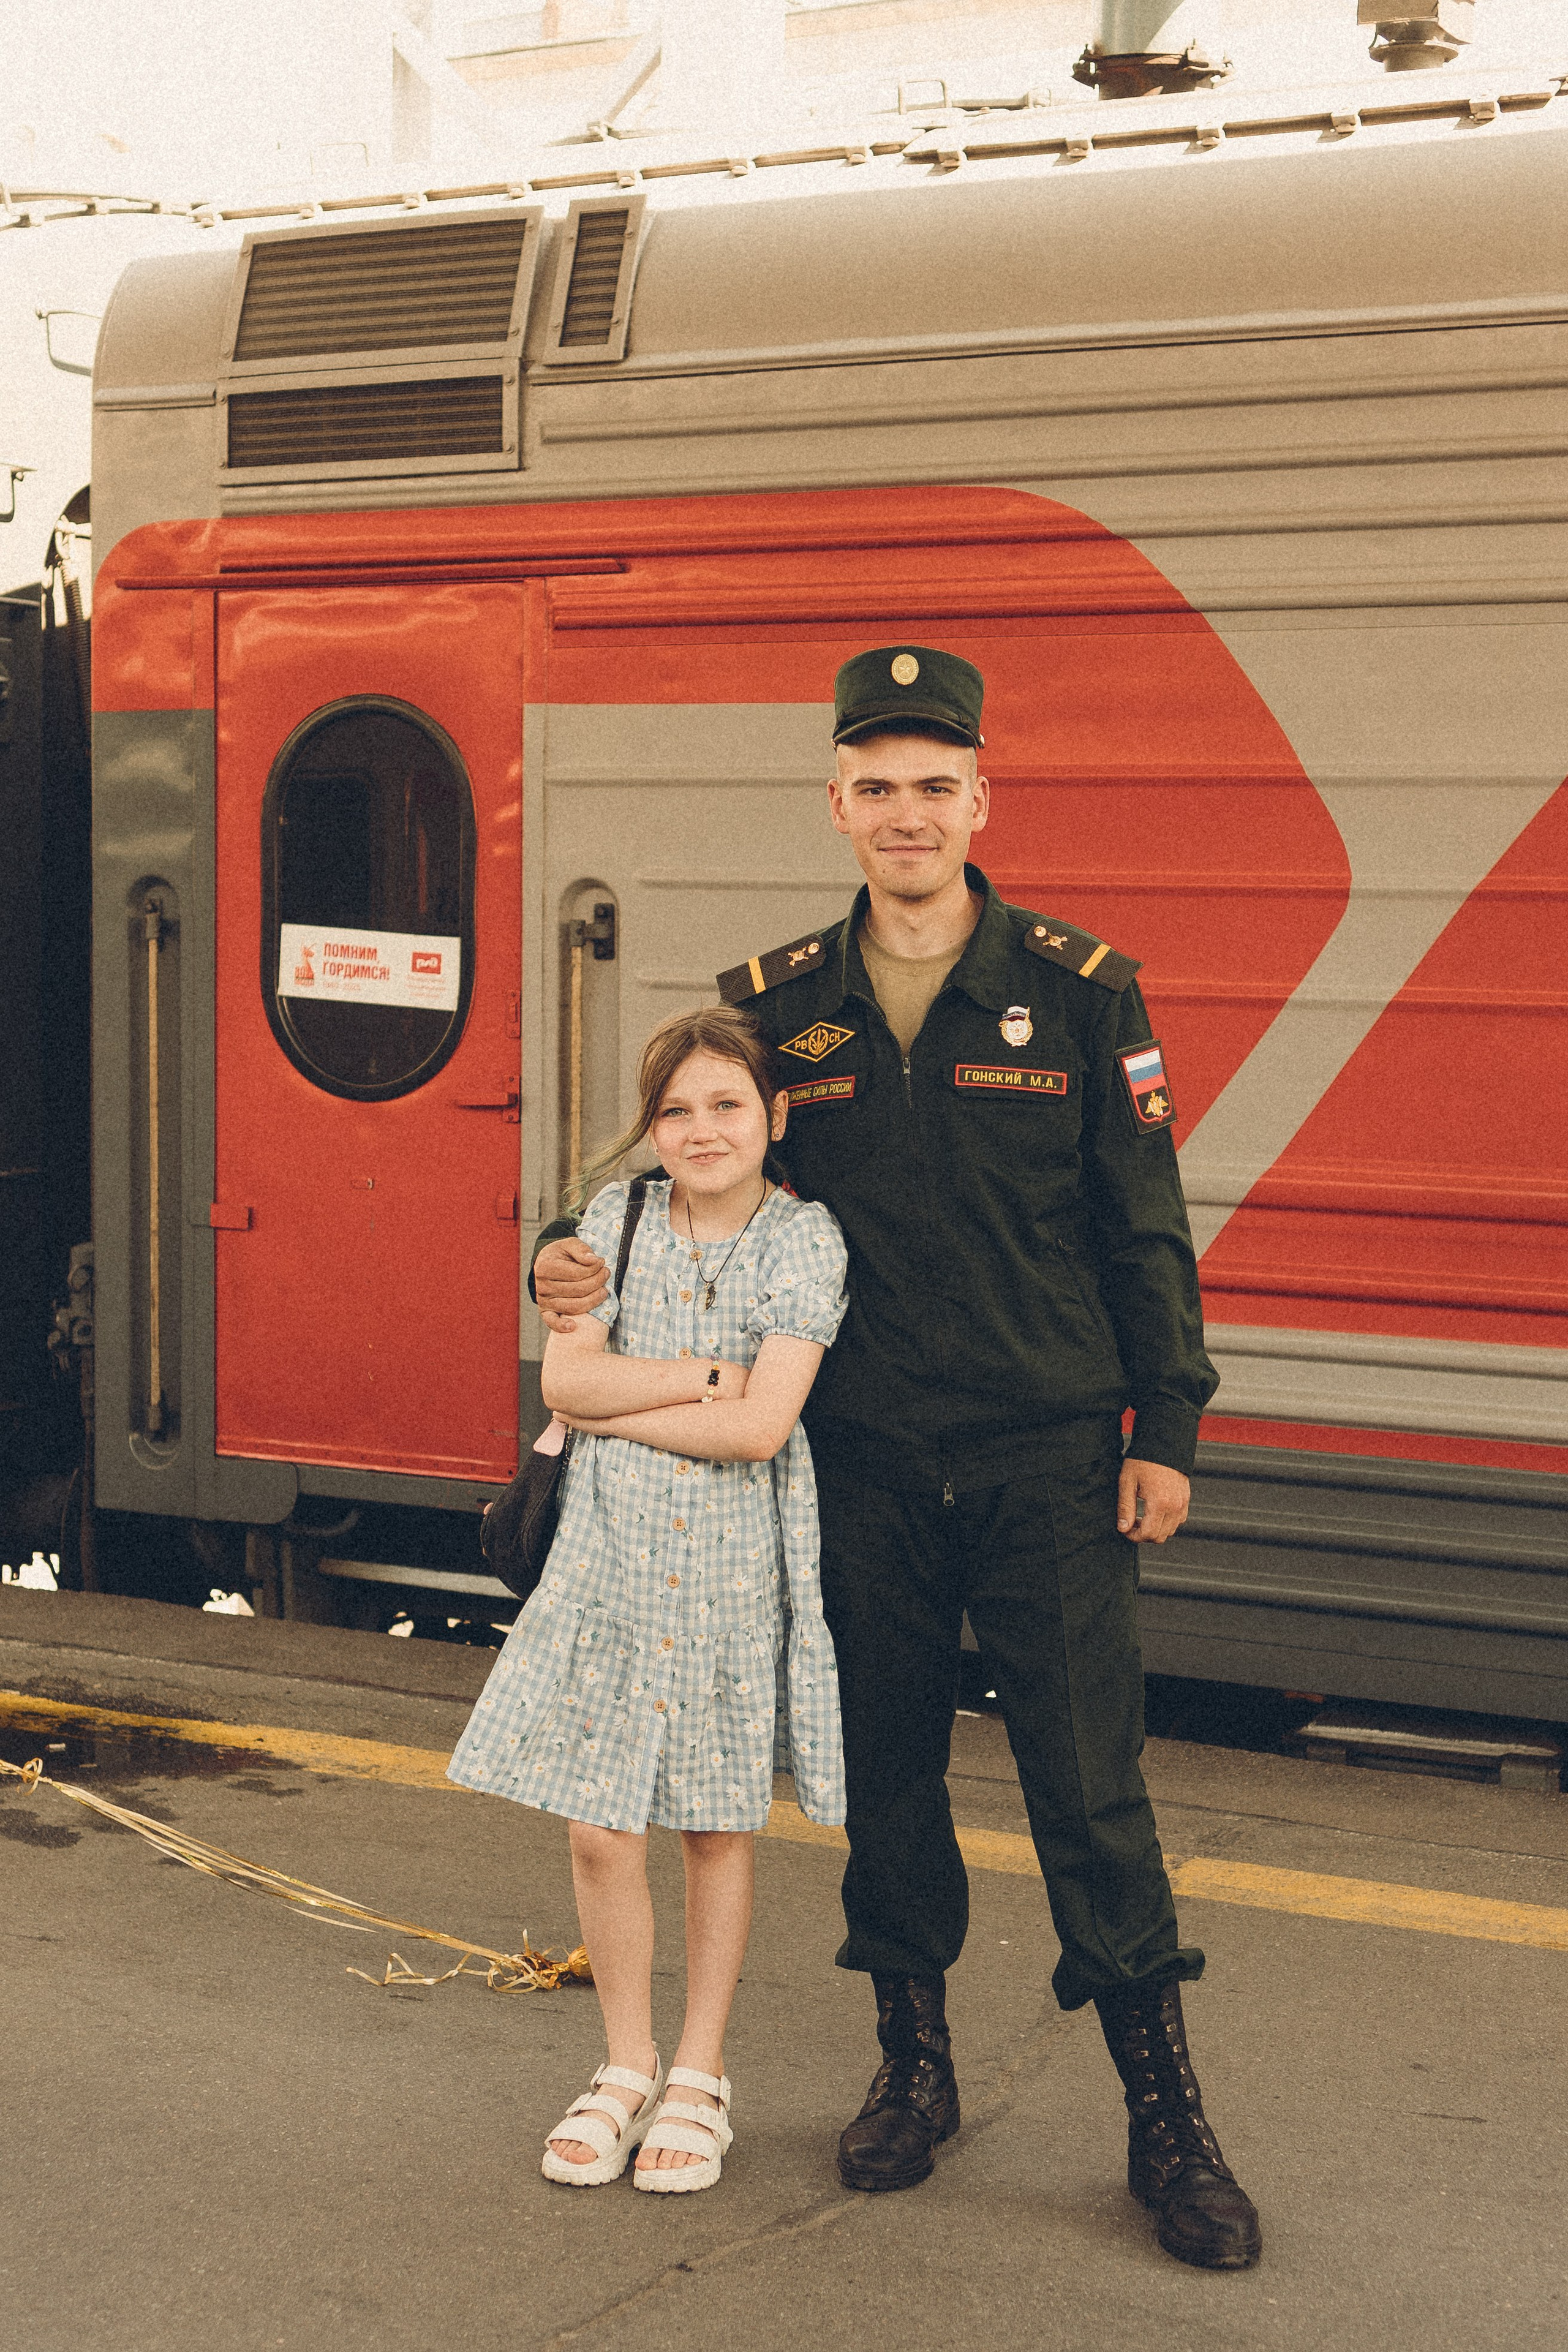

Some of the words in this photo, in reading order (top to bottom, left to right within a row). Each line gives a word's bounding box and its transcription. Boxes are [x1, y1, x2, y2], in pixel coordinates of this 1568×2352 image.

[322, 962, 390, 981] ГОРДИМСЯ!
[795, 1039, 807, 1050] РВ
[829, 1031, 840, 1043] СН
[965, 1070, 1022, 1085] ГОНСКИЙ
[1030, 1075, 1057, 1088] М.А.
[813, 1084, 828, 1096] СИЛЫ
[829, 1082, 852, 1094] РОССИИ
